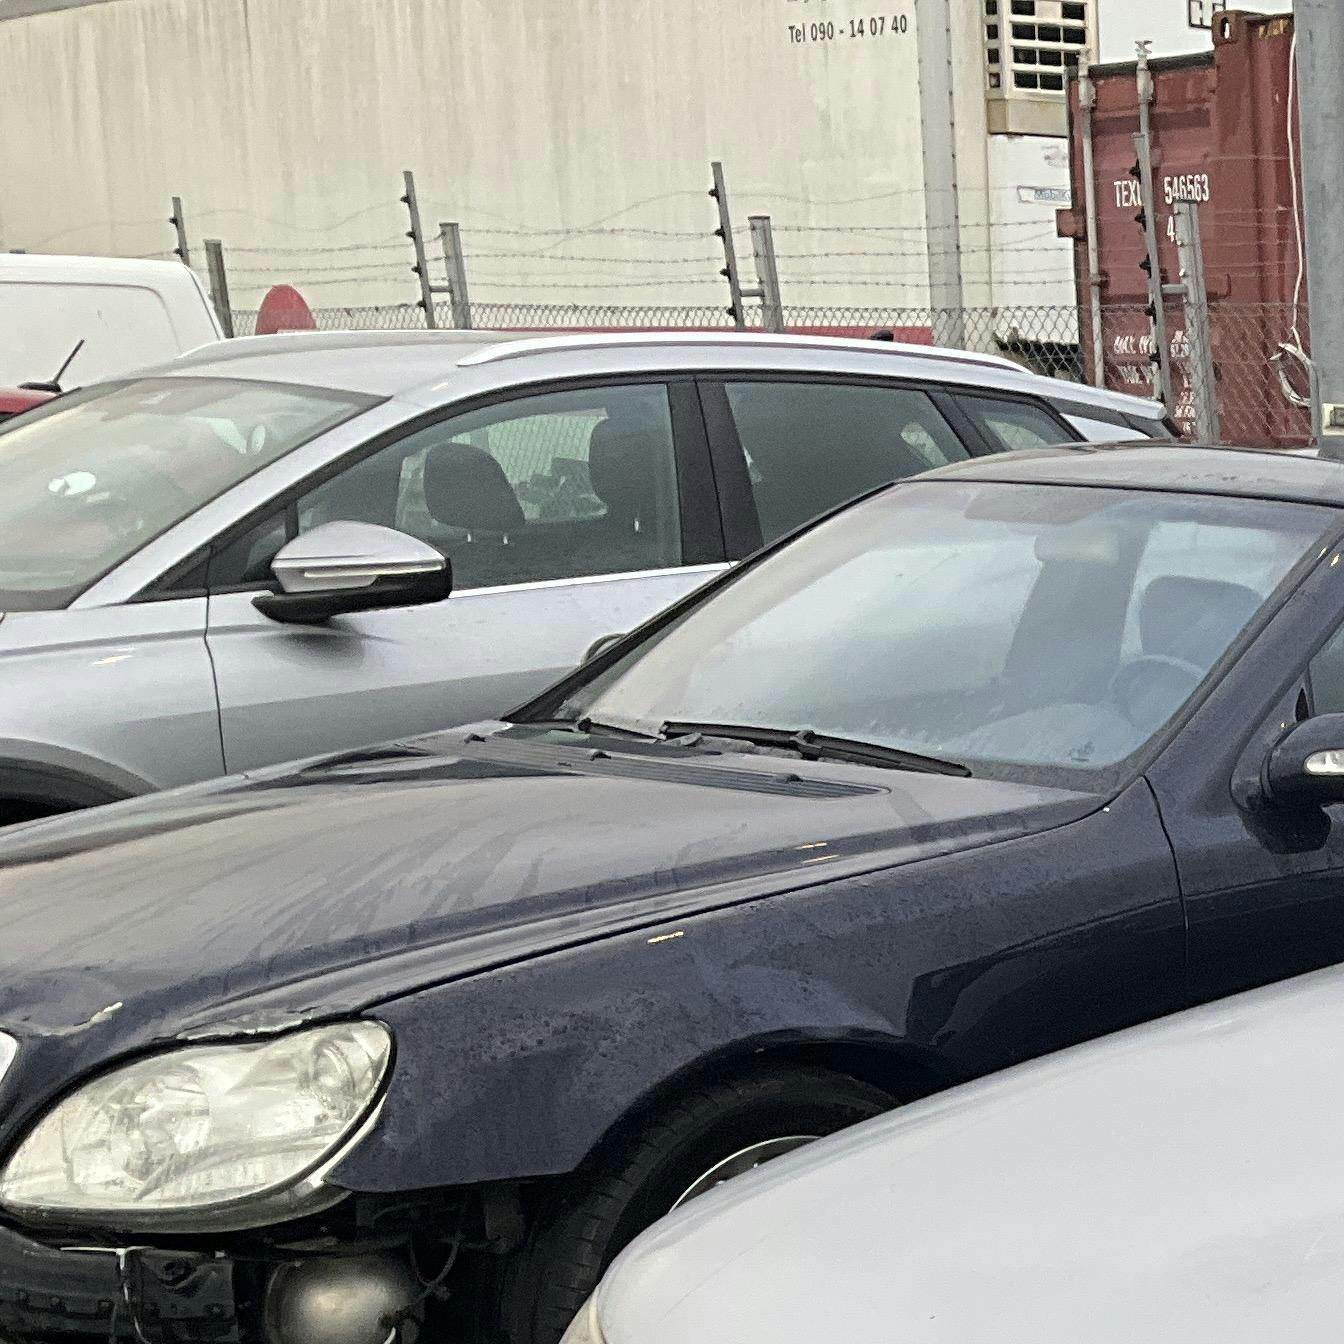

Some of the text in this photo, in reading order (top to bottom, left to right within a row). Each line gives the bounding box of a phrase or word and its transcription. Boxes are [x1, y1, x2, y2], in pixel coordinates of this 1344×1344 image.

[788, 22, 806, 43] Tel
[810, 20, 834, 41] 090
[849, 18, 864, 38] 14
[869, 16, 885, 36] 07
[891, 14, 907, 34] 40
[1163, 173, 1210, 205] 546563
